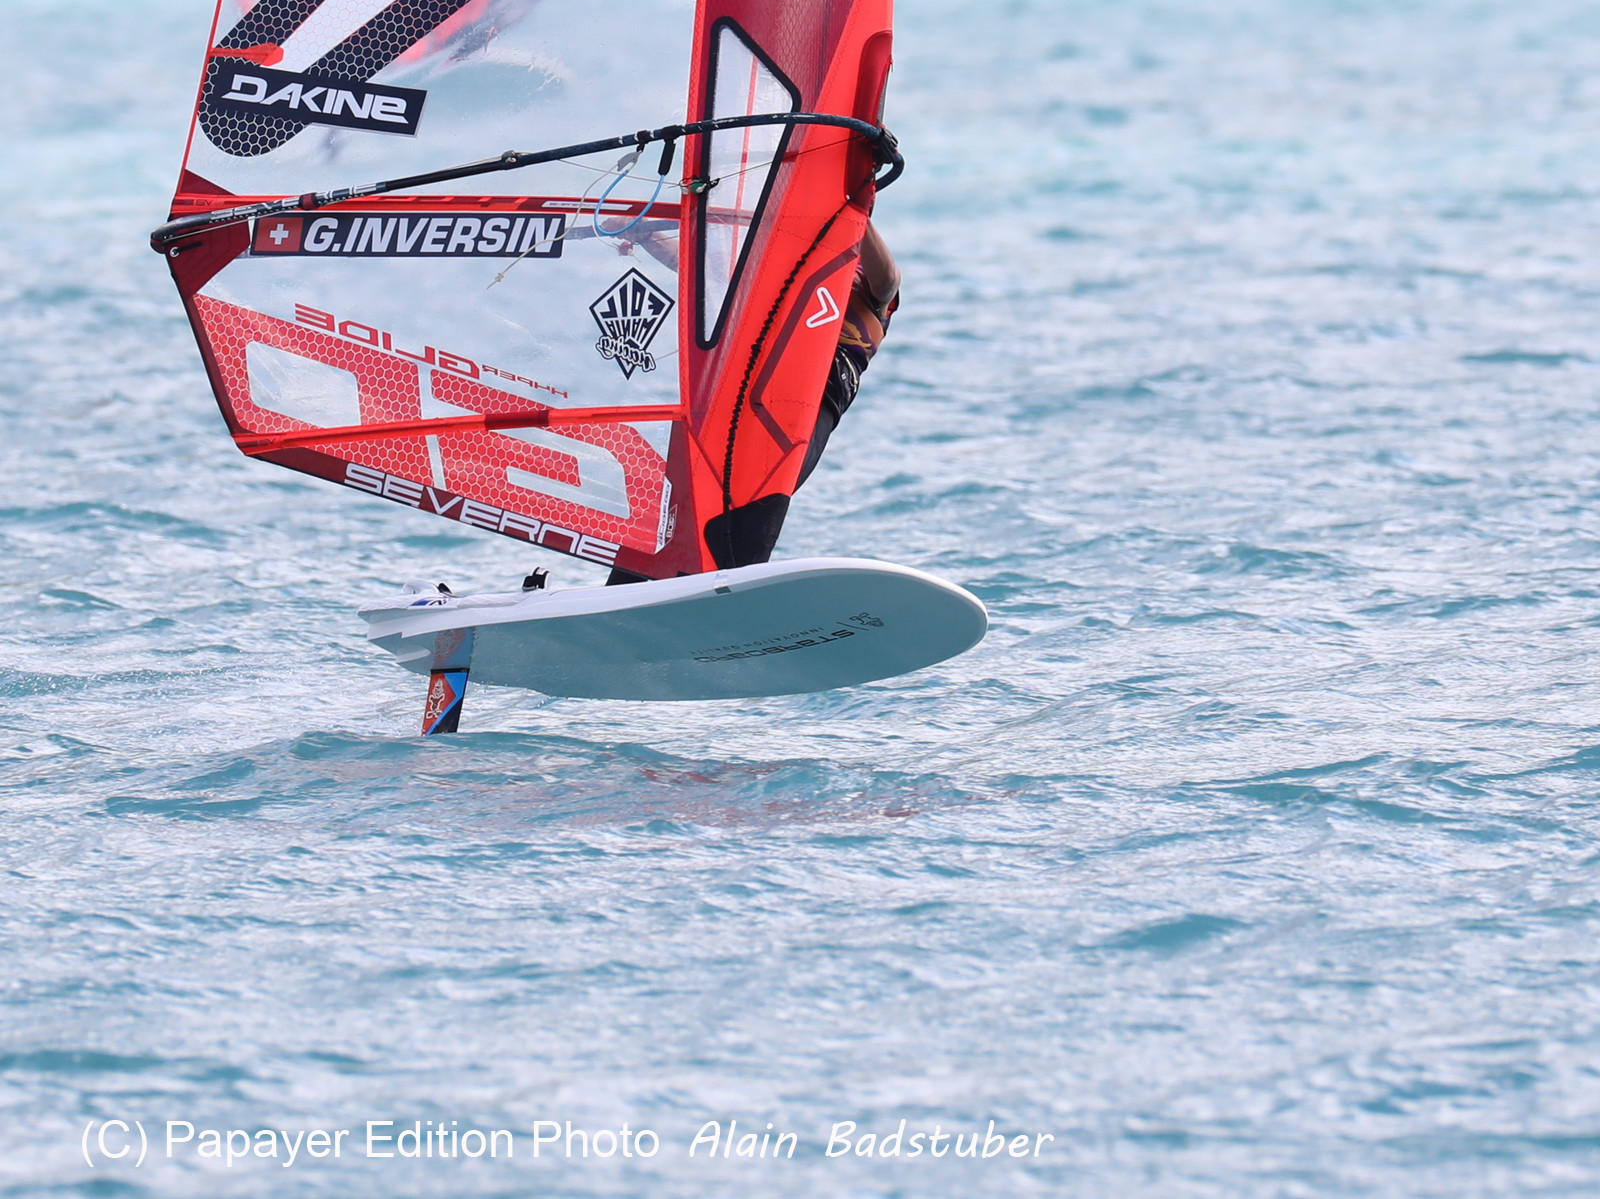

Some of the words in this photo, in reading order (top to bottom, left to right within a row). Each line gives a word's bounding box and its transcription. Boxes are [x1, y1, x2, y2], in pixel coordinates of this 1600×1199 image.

[222, 74, 409, 124] DAKINE
[304, 216, 563, 255] G.INVERSIN
[344, 462, 621, 566] SEVERNE
